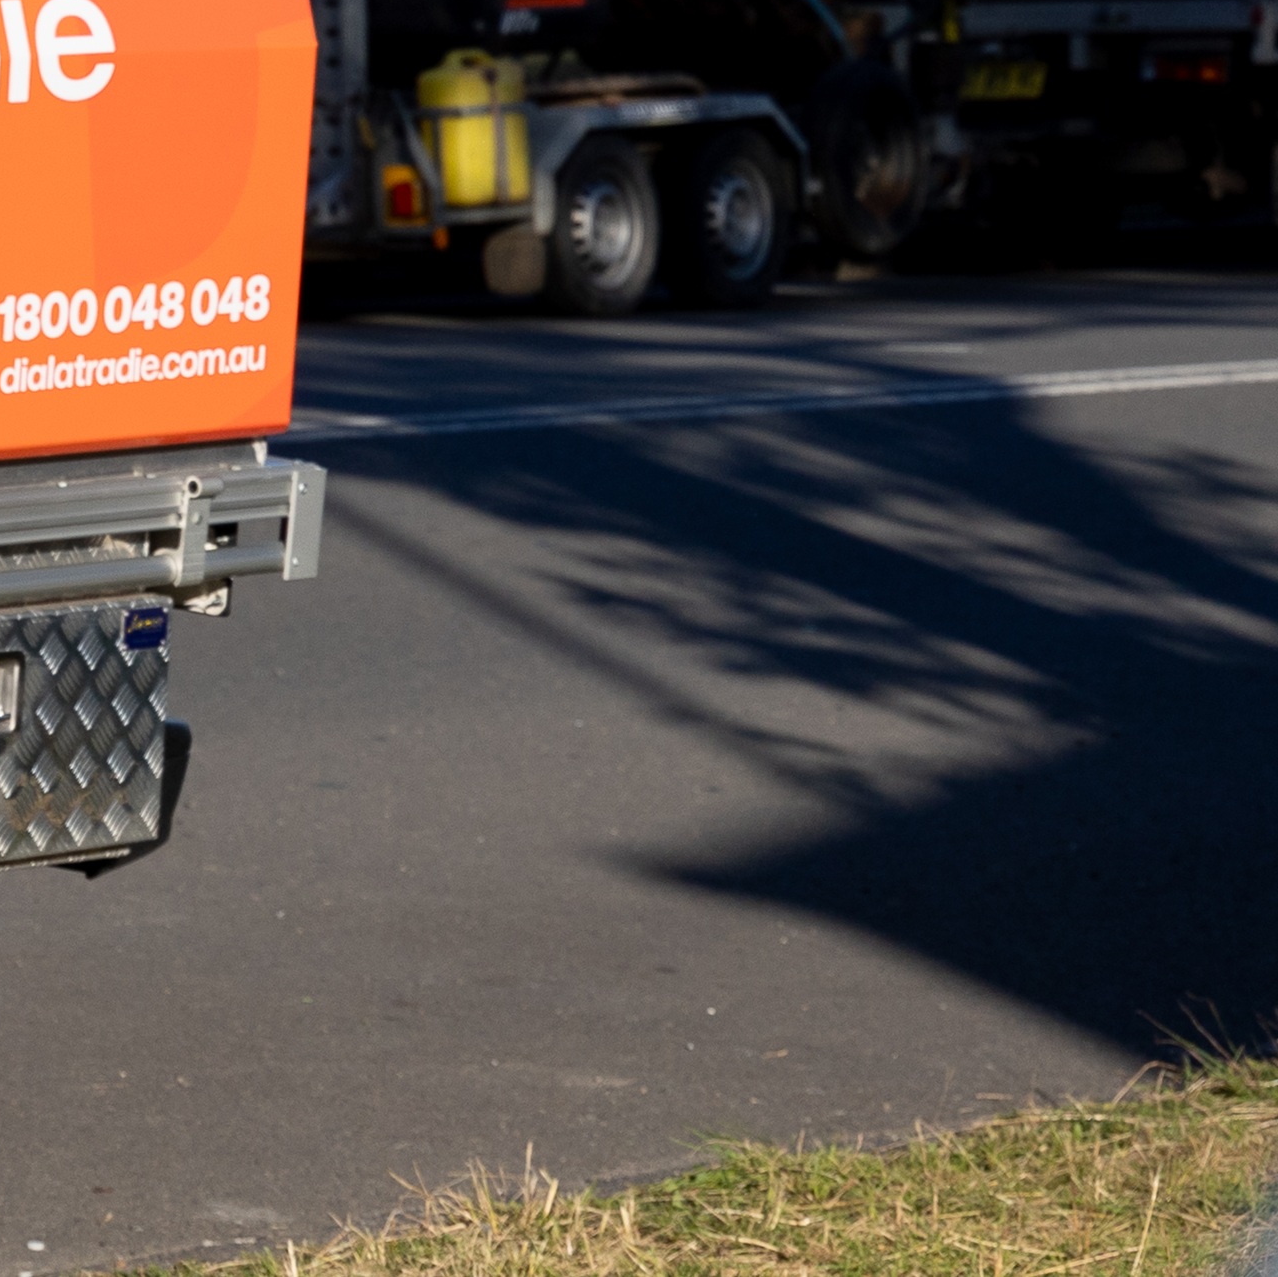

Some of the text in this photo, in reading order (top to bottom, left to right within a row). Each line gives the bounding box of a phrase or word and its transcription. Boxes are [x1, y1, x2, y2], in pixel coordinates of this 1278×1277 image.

[103, 281, 186, 334] 048
[190, 274, 272, 326] 048
[0, 344, 267, 395] dialatradie.com.au
